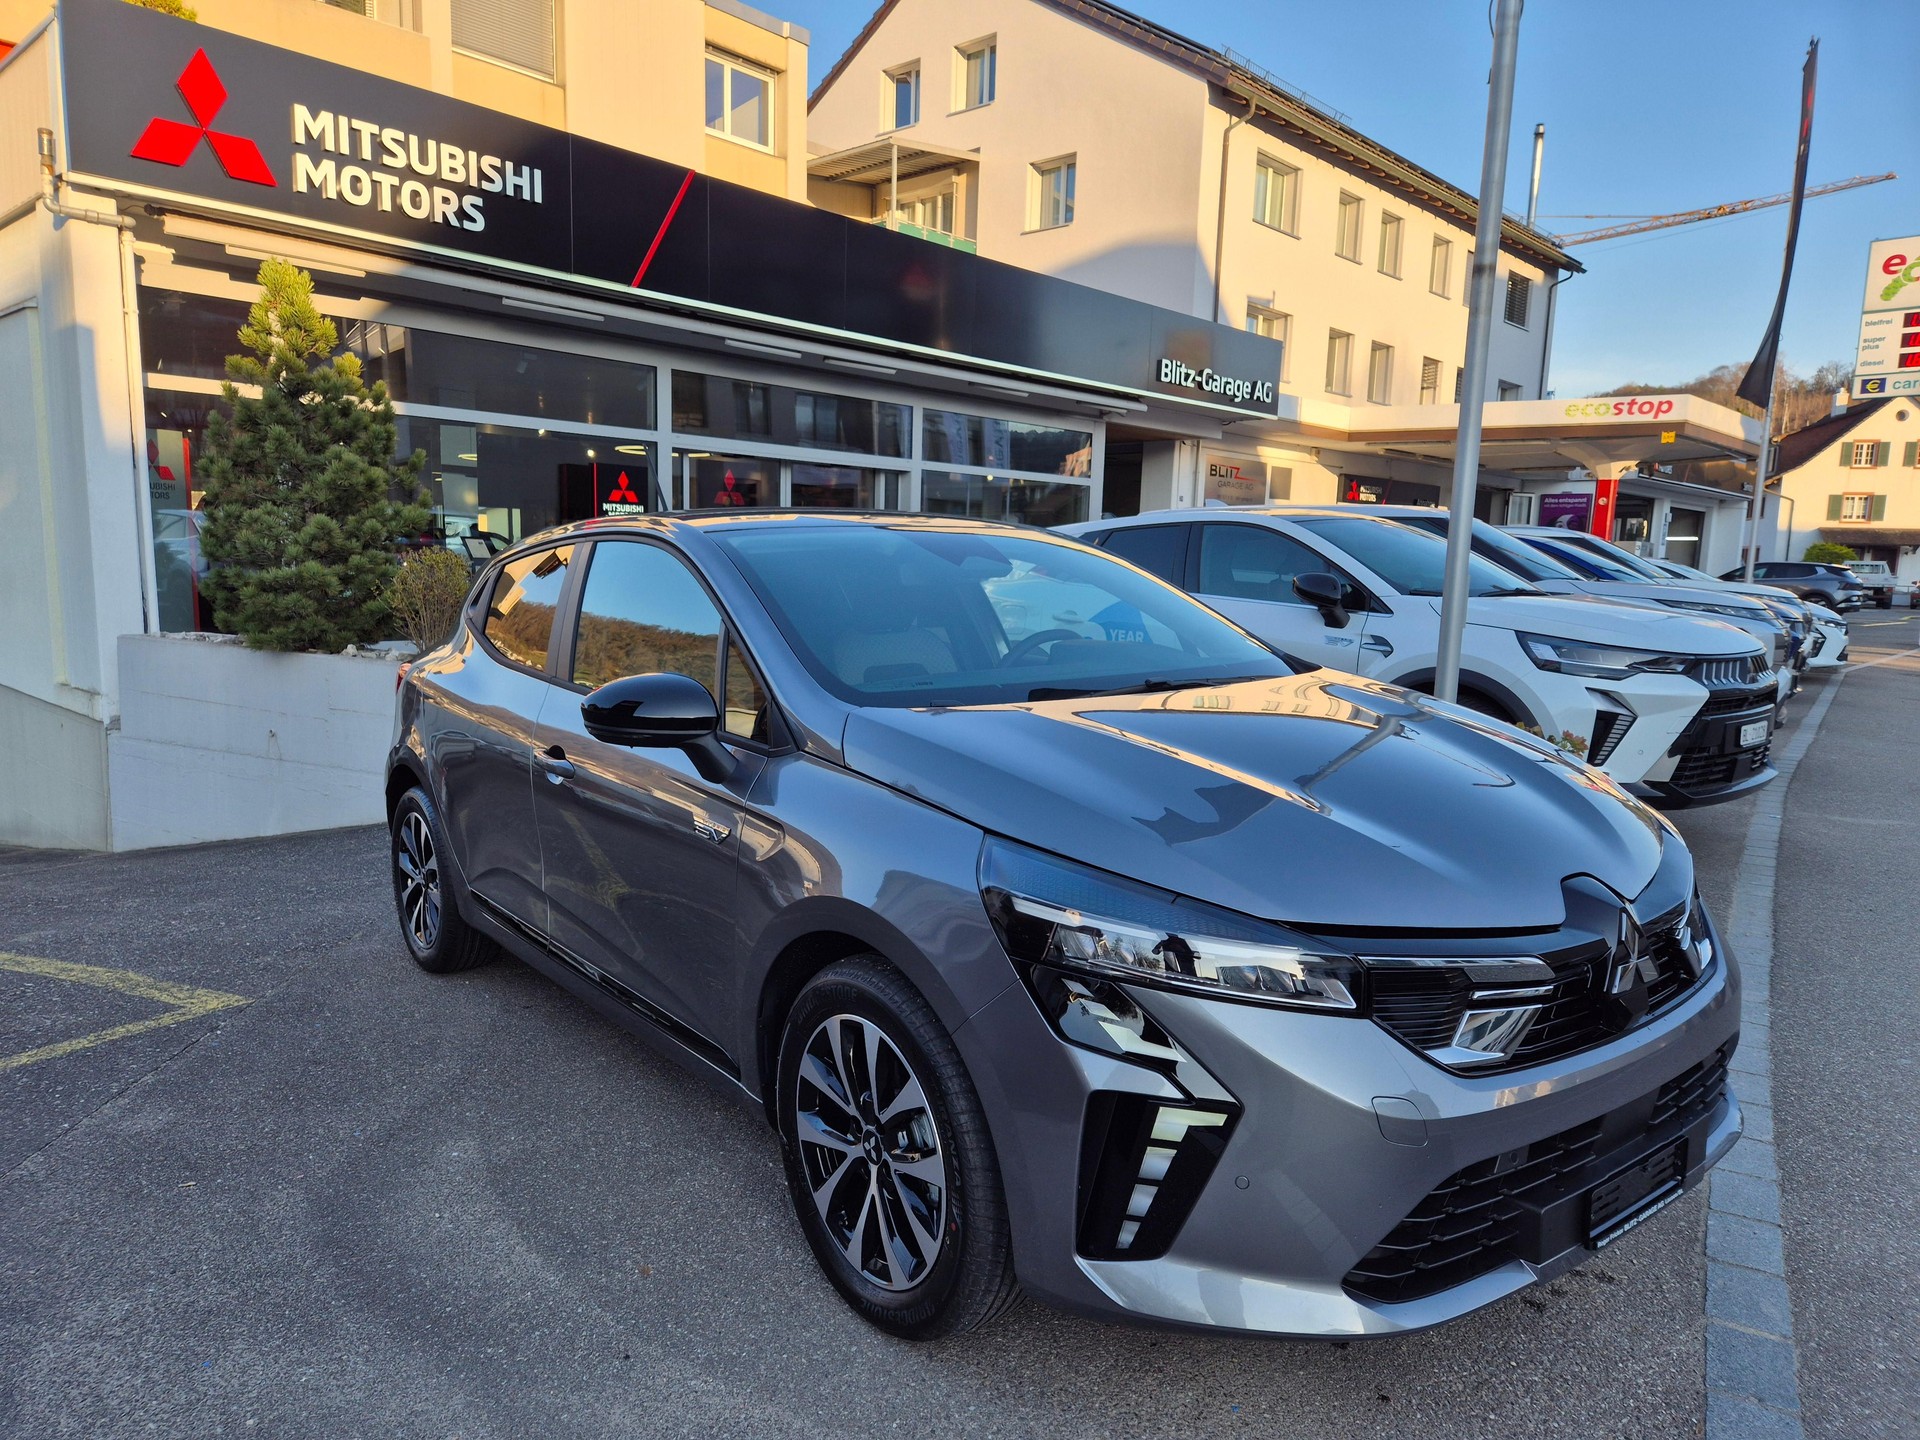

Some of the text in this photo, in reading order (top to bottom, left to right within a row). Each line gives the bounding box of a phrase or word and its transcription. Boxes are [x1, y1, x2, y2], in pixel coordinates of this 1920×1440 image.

[291, 103, 543, 204] MITSUBISHI
[292, 152, 486, 232] MOTORS
[1863, 336, 1886, 344] super
[1861, 344, 1880, 352] plus
[1860, 359, 1884, 367] diesel
[1160, 358, 1273, 403] Blitz-Garage AG
[1892, 379, 1920, 390] car
[1565, 398, 1673, 419] ecostop
[150, 483, 176, 491] UBISHI
[1217, 480, 1243, 491] GARAGE
[151, 491, 170, 499] TORS
[603, 502, 644, 513] MITSUBISHI
[1110, 628, 1144, 642] YEAR
